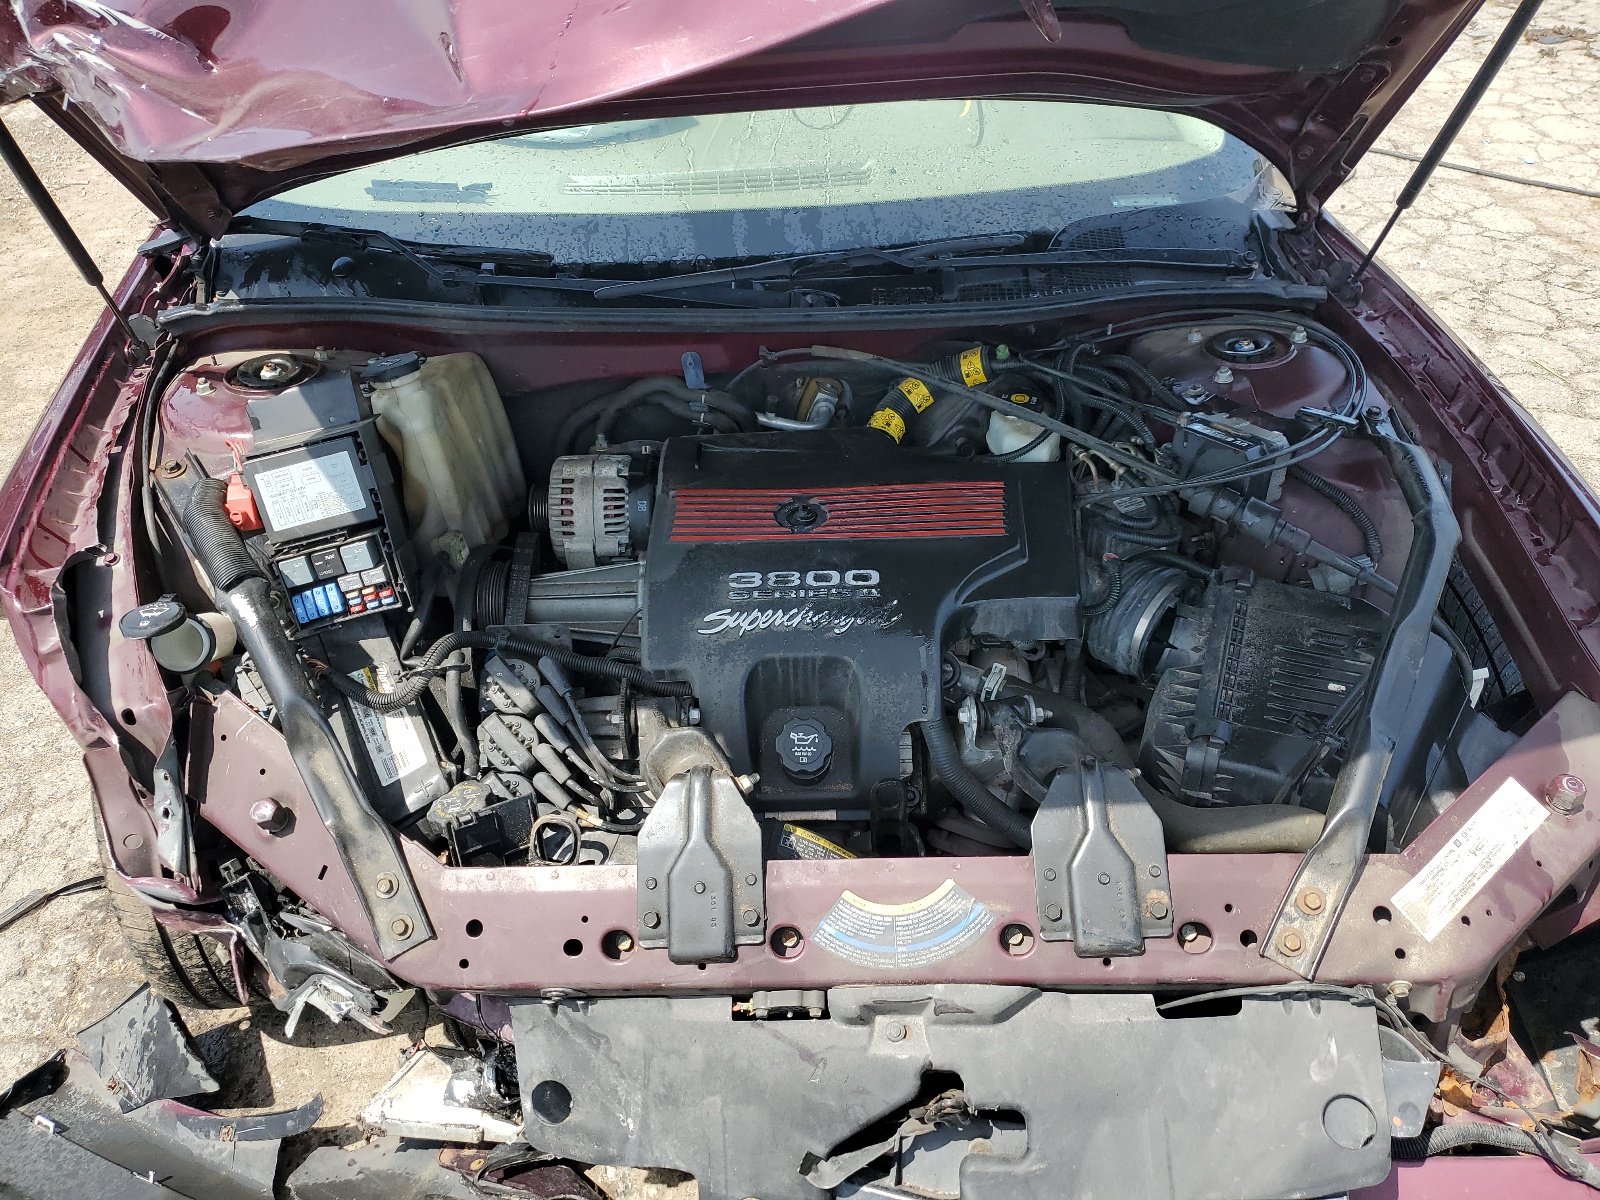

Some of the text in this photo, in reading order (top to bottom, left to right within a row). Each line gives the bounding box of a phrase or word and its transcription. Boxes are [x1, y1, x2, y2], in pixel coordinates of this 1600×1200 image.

[728, 569, 880, 588] 3800
[727, 588, 853, 600] SERIES
[698, 599, 903, 637] Supercharged
